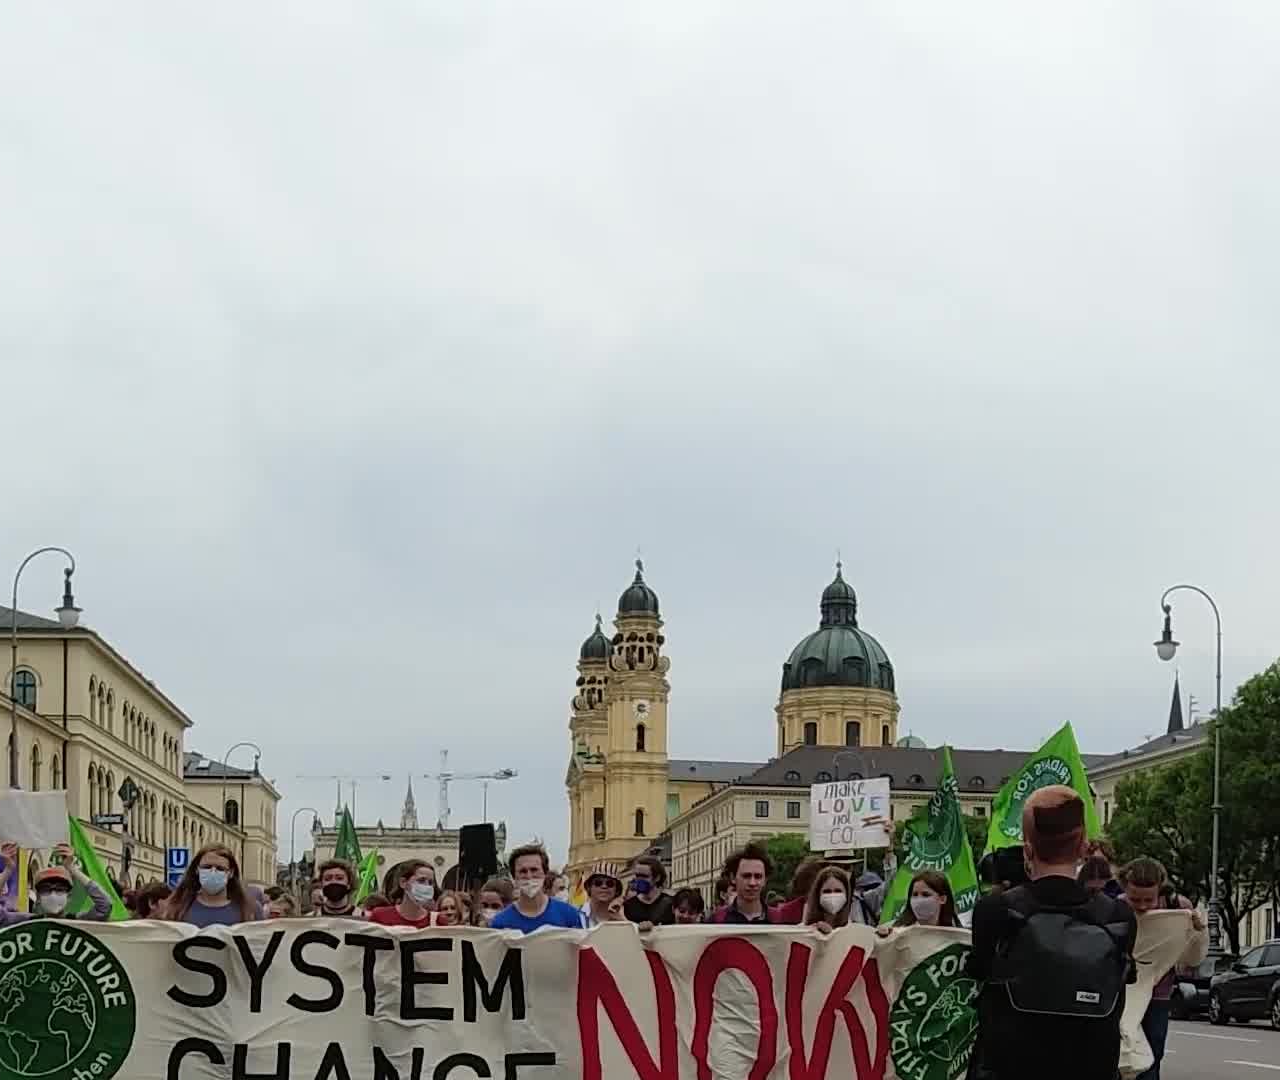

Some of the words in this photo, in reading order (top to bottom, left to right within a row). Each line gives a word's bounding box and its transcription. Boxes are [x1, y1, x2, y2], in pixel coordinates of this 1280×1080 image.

[824, 782, 865, 799] make
[818, 796, 884, 813] LOVE
[832, 808, 852, 825] not
[172, 850, 185, 866] U
[44, 930, 128, 1009] FUTURE
[166, 930, 526, 1023] SYSTEM
